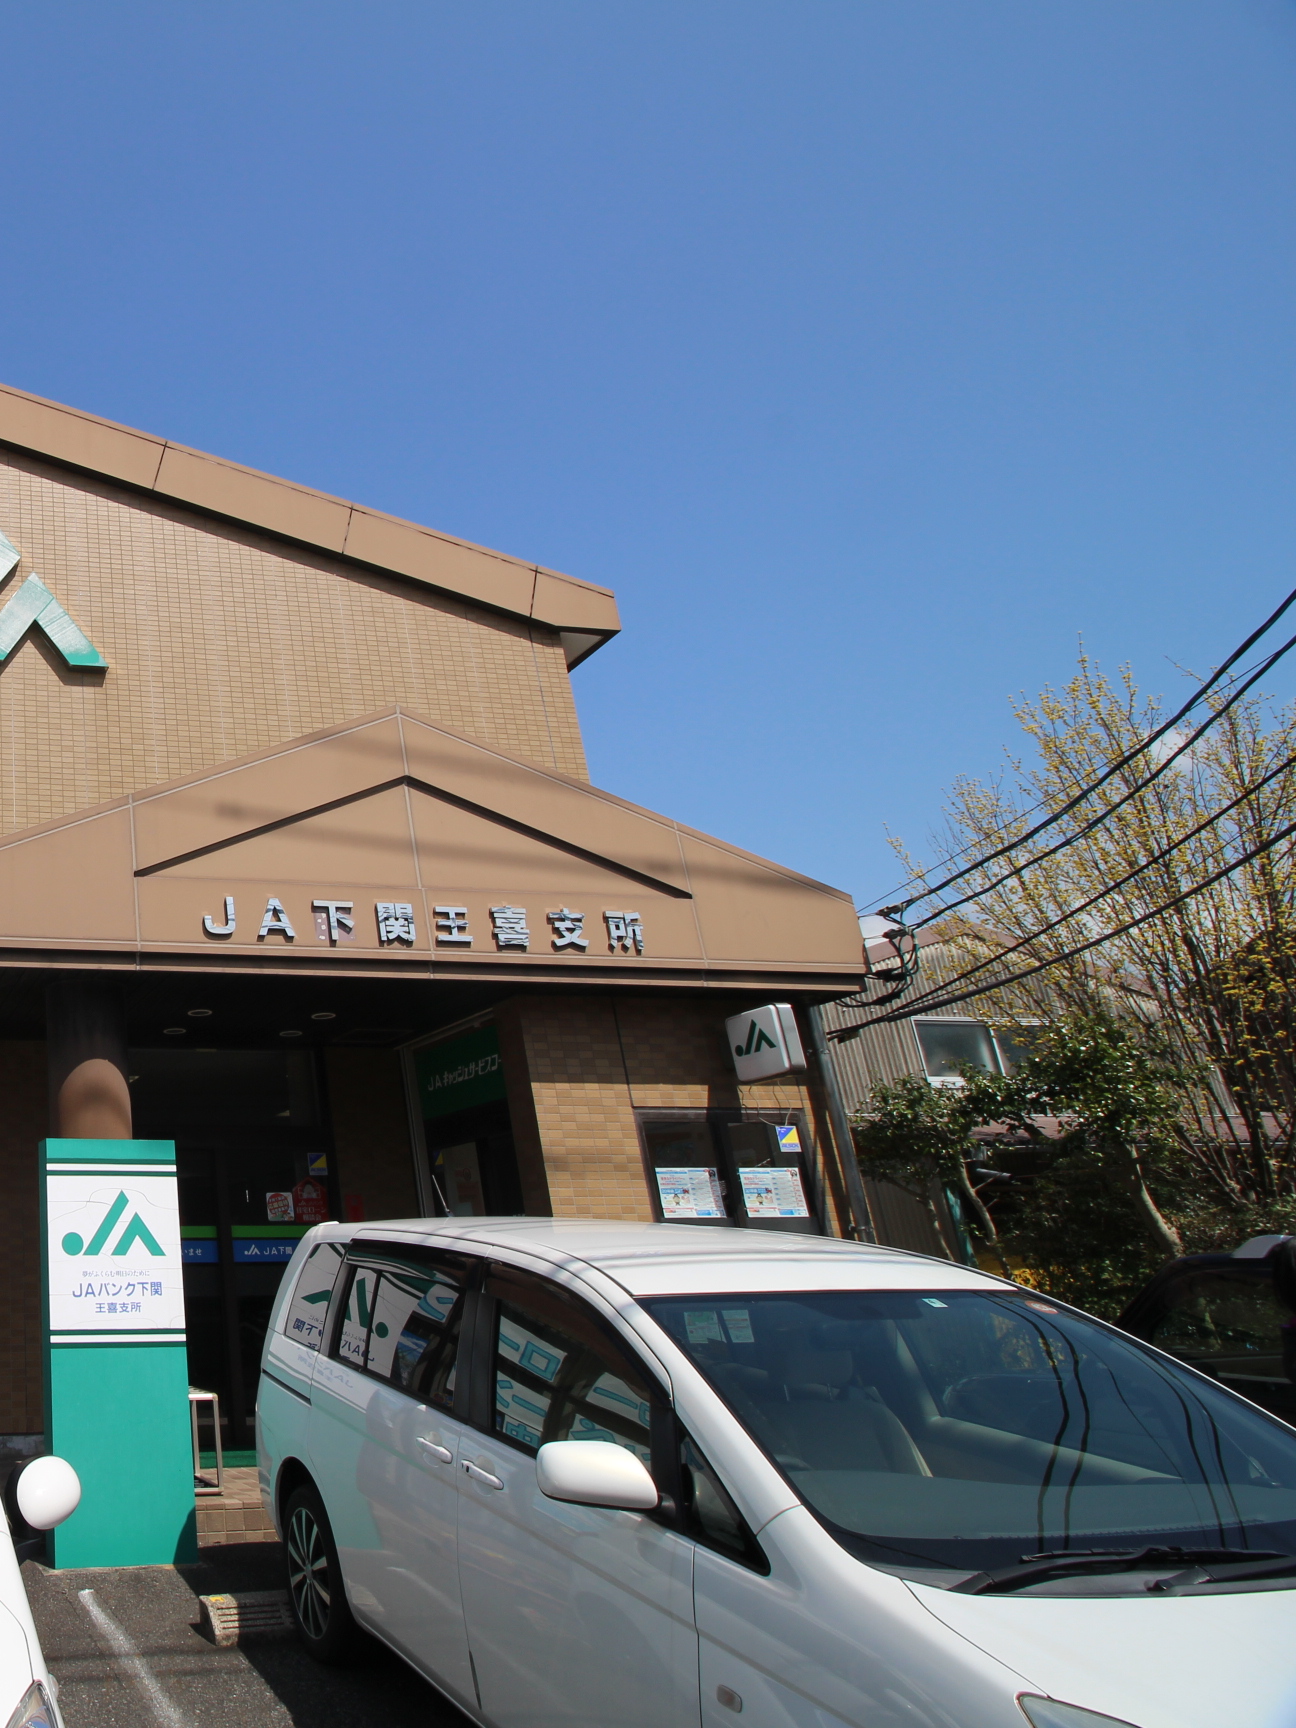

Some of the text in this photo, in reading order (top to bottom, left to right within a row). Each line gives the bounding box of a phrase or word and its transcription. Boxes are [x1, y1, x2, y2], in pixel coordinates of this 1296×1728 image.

[204, 896, 644, 953] JA下関王喜支所
[263, 1246, 292, 1255] JA下関
[82, 1270, 150, 1278] 夢がふくらむ明日のために
[72, 1281, 163, 1298] JAバンク下関
[95, 1302, 142, 1314] 王喜支所
